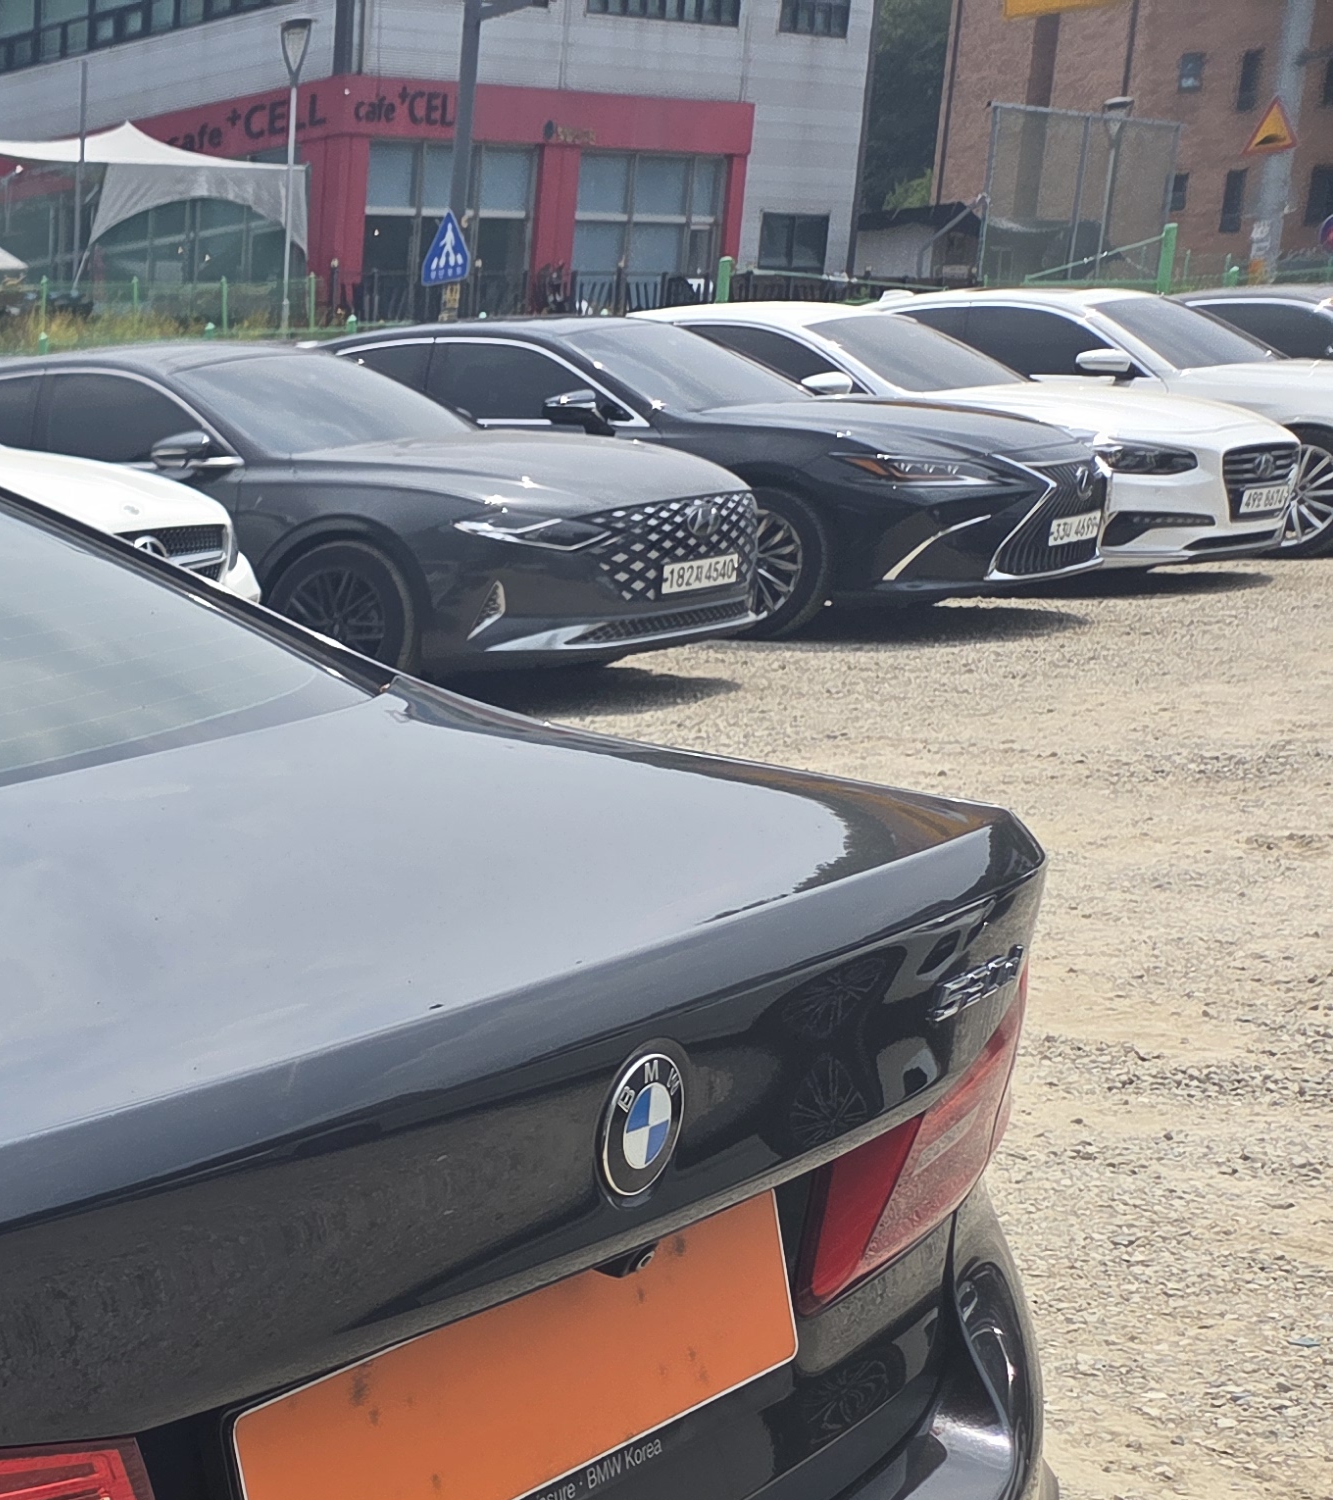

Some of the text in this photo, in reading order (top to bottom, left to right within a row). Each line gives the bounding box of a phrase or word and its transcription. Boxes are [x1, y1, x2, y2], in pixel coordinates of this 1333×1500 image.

[354, 95, 396, 123] cafe
[617, 1059, 680, 1113] BMW
[586, 1454, 622, 1490] BMW
[625, 1438, 663, 1470] Korea
